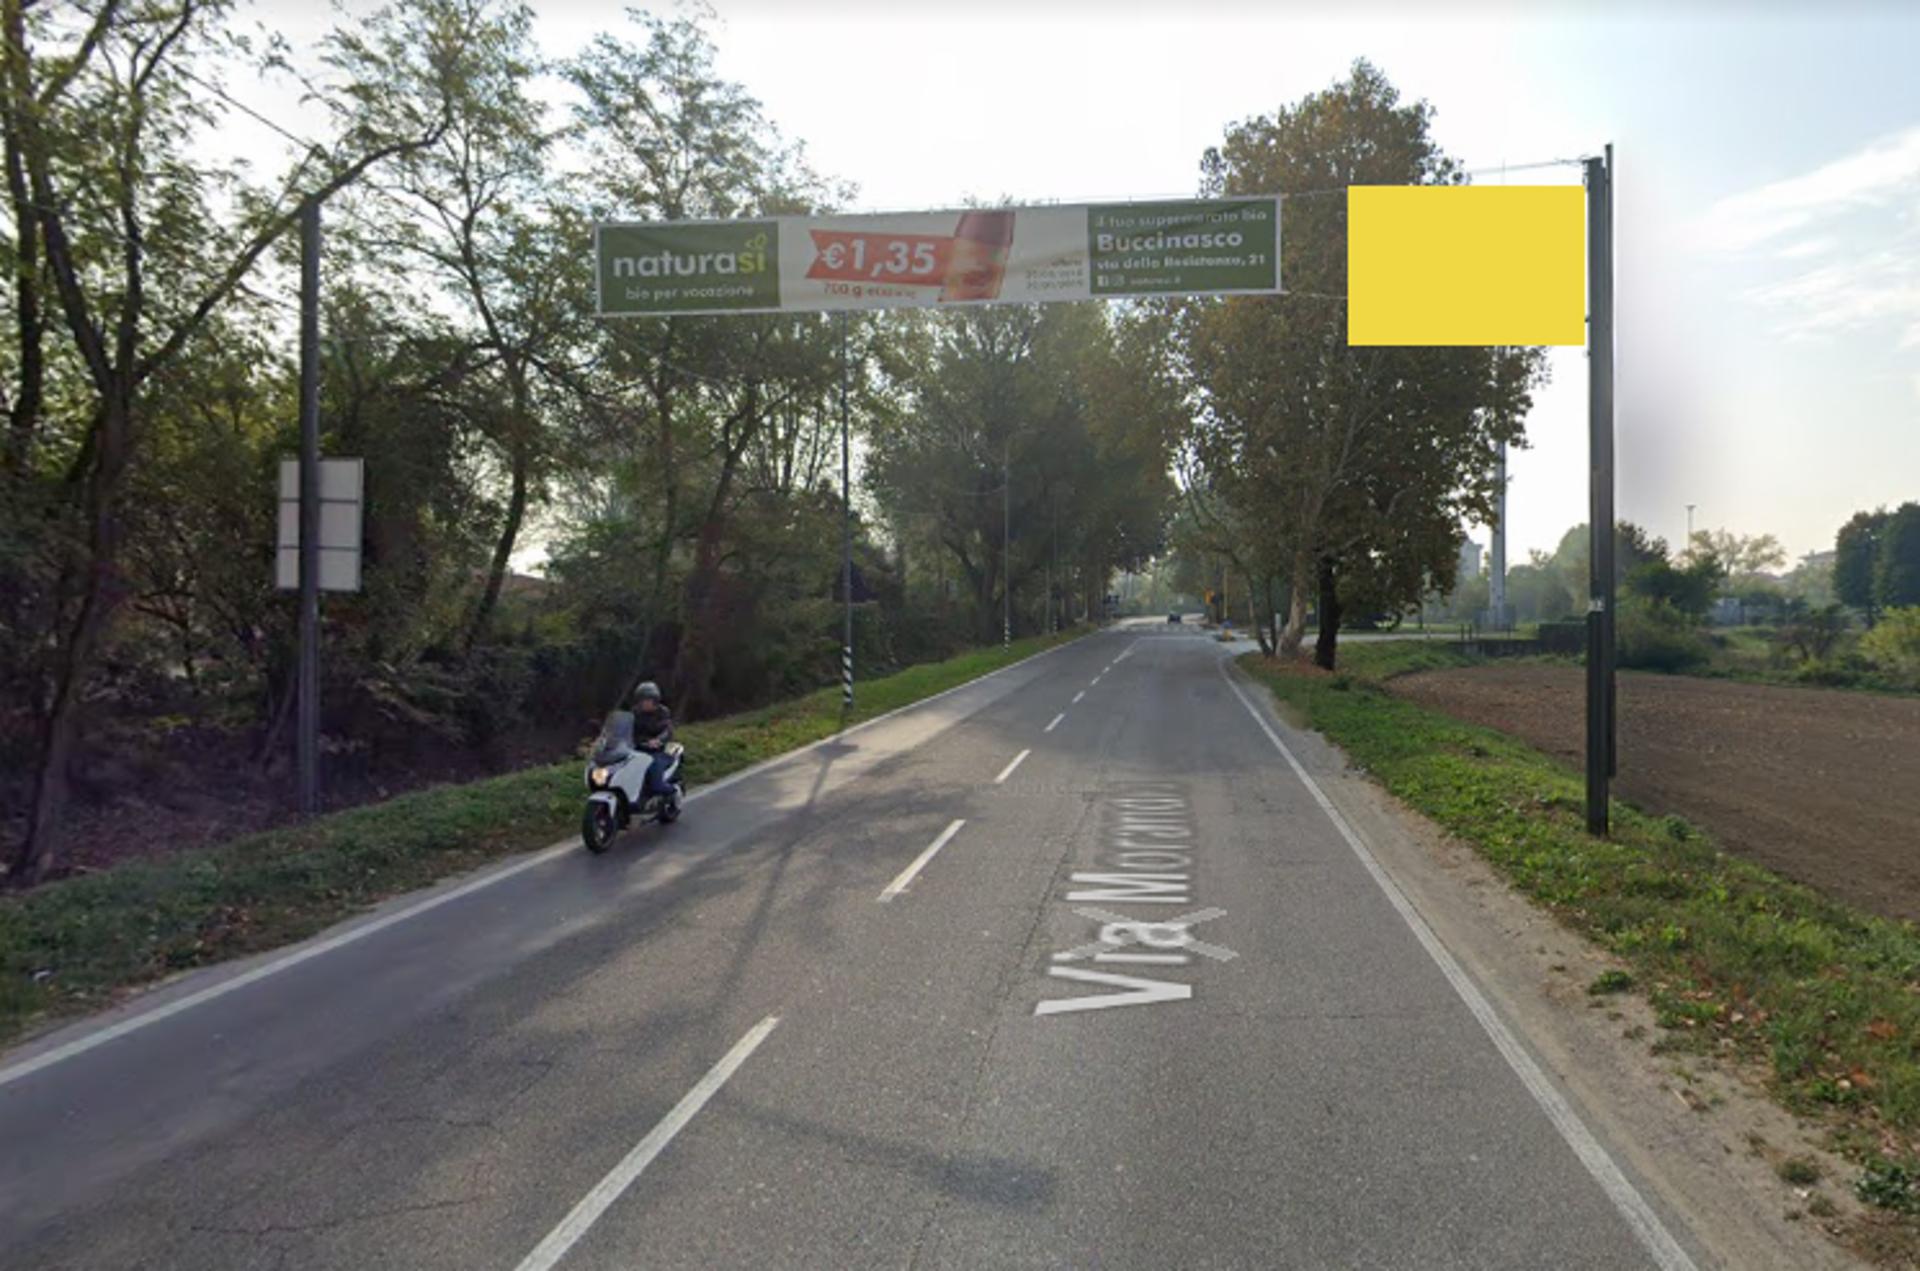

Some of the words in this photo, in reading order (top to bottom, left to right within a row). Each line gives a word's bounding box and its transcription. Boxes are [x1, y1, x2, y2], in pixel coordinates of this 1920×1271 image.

[1109, 213, 1135, 227] tuo
[1241, 208, 1268, 221] bio
[1097, 231, 1244, 252] Buccinasco
[821, 239, 935, 278] €1,35
[1097, 259, 1119, 270] via
[1248, 253, 1266, 266] 21
[625, 286, 650, 300] bio
[653, 287, 678, 304] per
